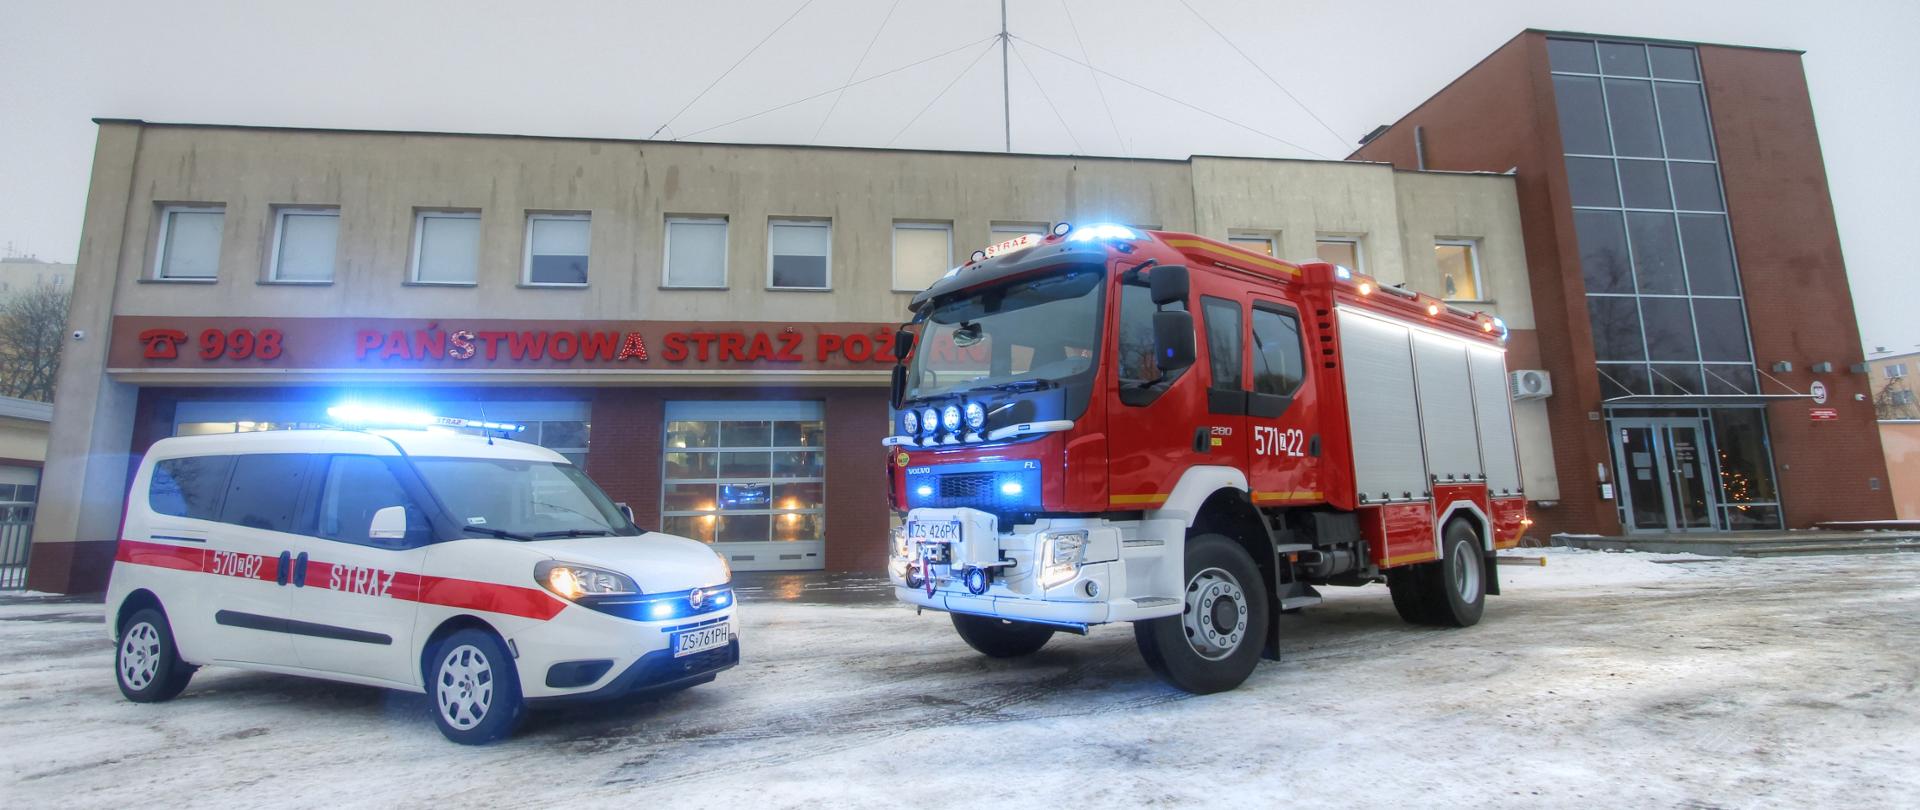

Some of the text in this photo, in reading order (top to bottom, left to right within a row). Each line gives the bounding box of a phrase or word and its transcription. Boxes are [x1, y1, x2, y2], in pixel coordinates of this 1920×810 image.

[200, 327, 283, 360] 998
[355, 322, 648, 361] PAŃSTWOWA
[662, 326, 804, 362] STRAŻ
[1211, 426, 1233, 436] 280
[908, 467, 930, 475] VOLVO
[1024, 461, 1036, 469] FL
[915, 524, 957, 539] ZS 426PK
[682, 627, 727, 650] ZS 761PH
